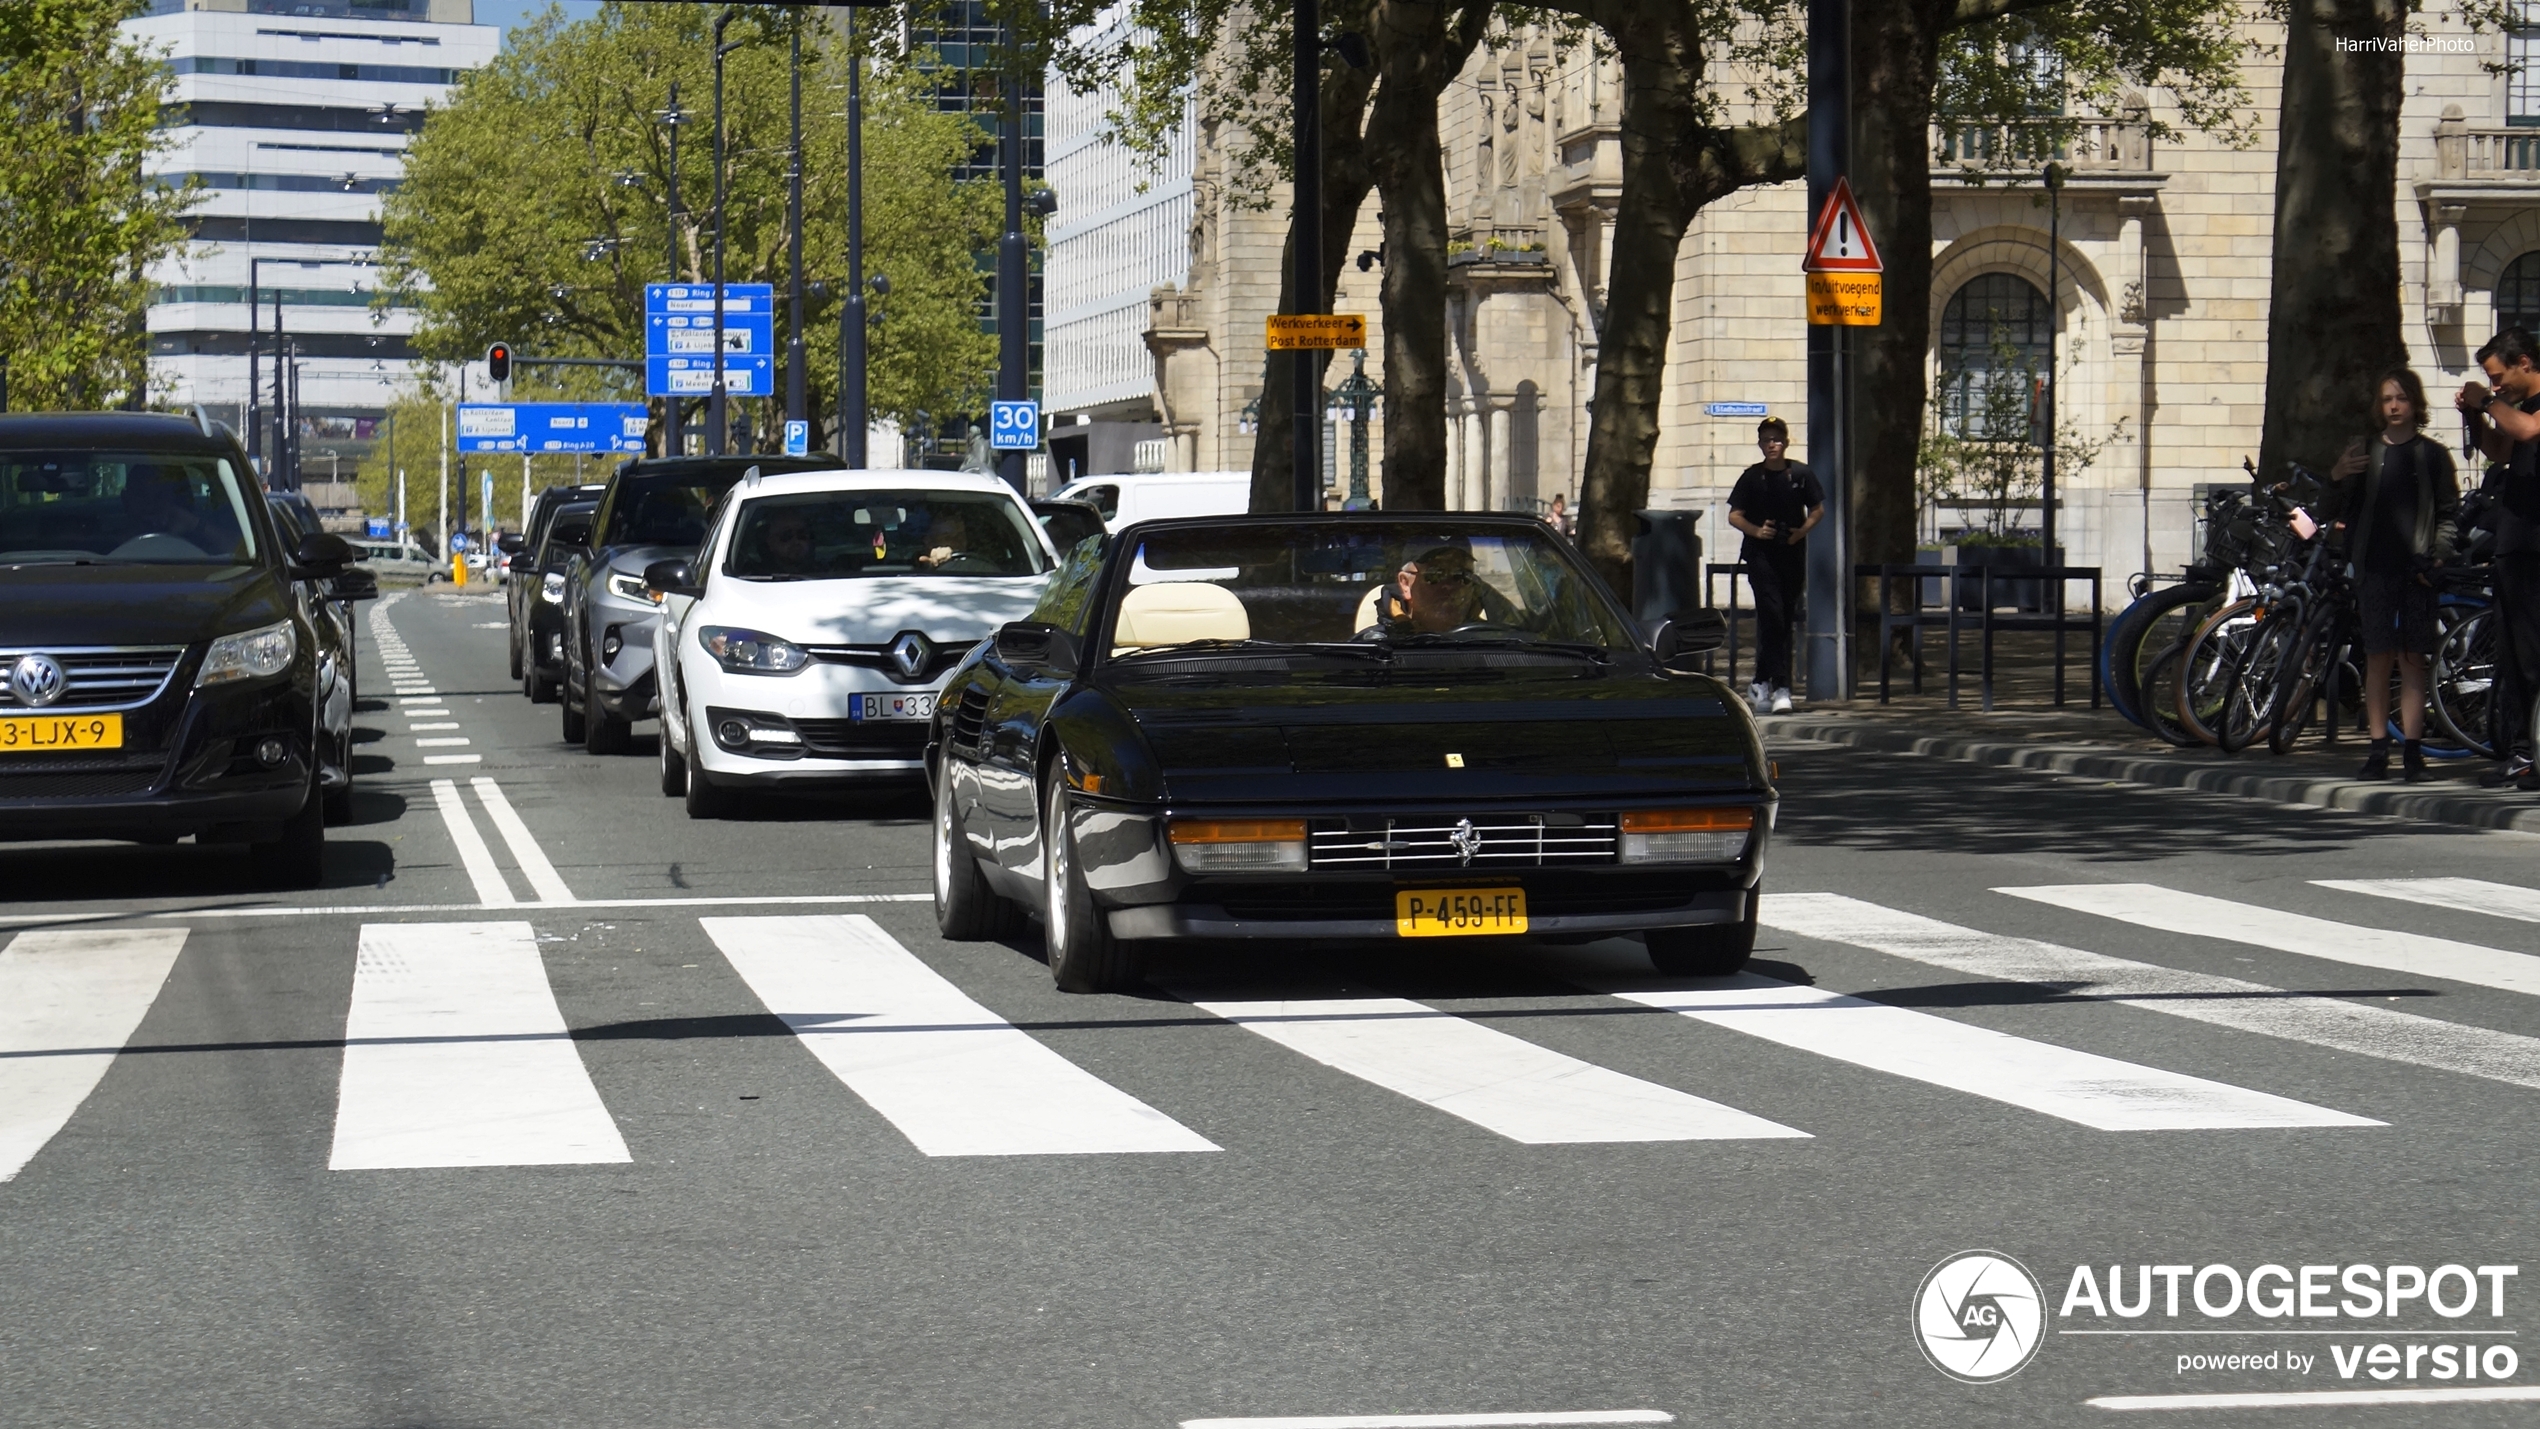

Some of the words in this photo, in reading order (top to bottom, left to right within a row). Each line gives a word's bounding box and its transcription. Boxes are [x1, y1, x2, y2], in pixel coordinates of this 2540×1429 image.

[692, 289, 710, 299] Ring
[1811, 279, 1880, 298] In/uitvoegend
[1271, 317, 1344, 329] Werkverkeer
[1271, 336, 1296, 346] Post
[1299, 335, 1360, 346] Rotterdam
[692, 359, 711, 369] Ring
[996, 406, 1034, 430] 30
[790, 424, 803, 441] P
[996, 431, 1033, 446] km/h
[563, 441, 579, 450] Ring
[865, 697, 892, 718] BL
[905, 696, 938, 717] 33
[0, 721, 105, 745] 3-LJX-9
[1410, 895, 1519, 930] P-459-FF
